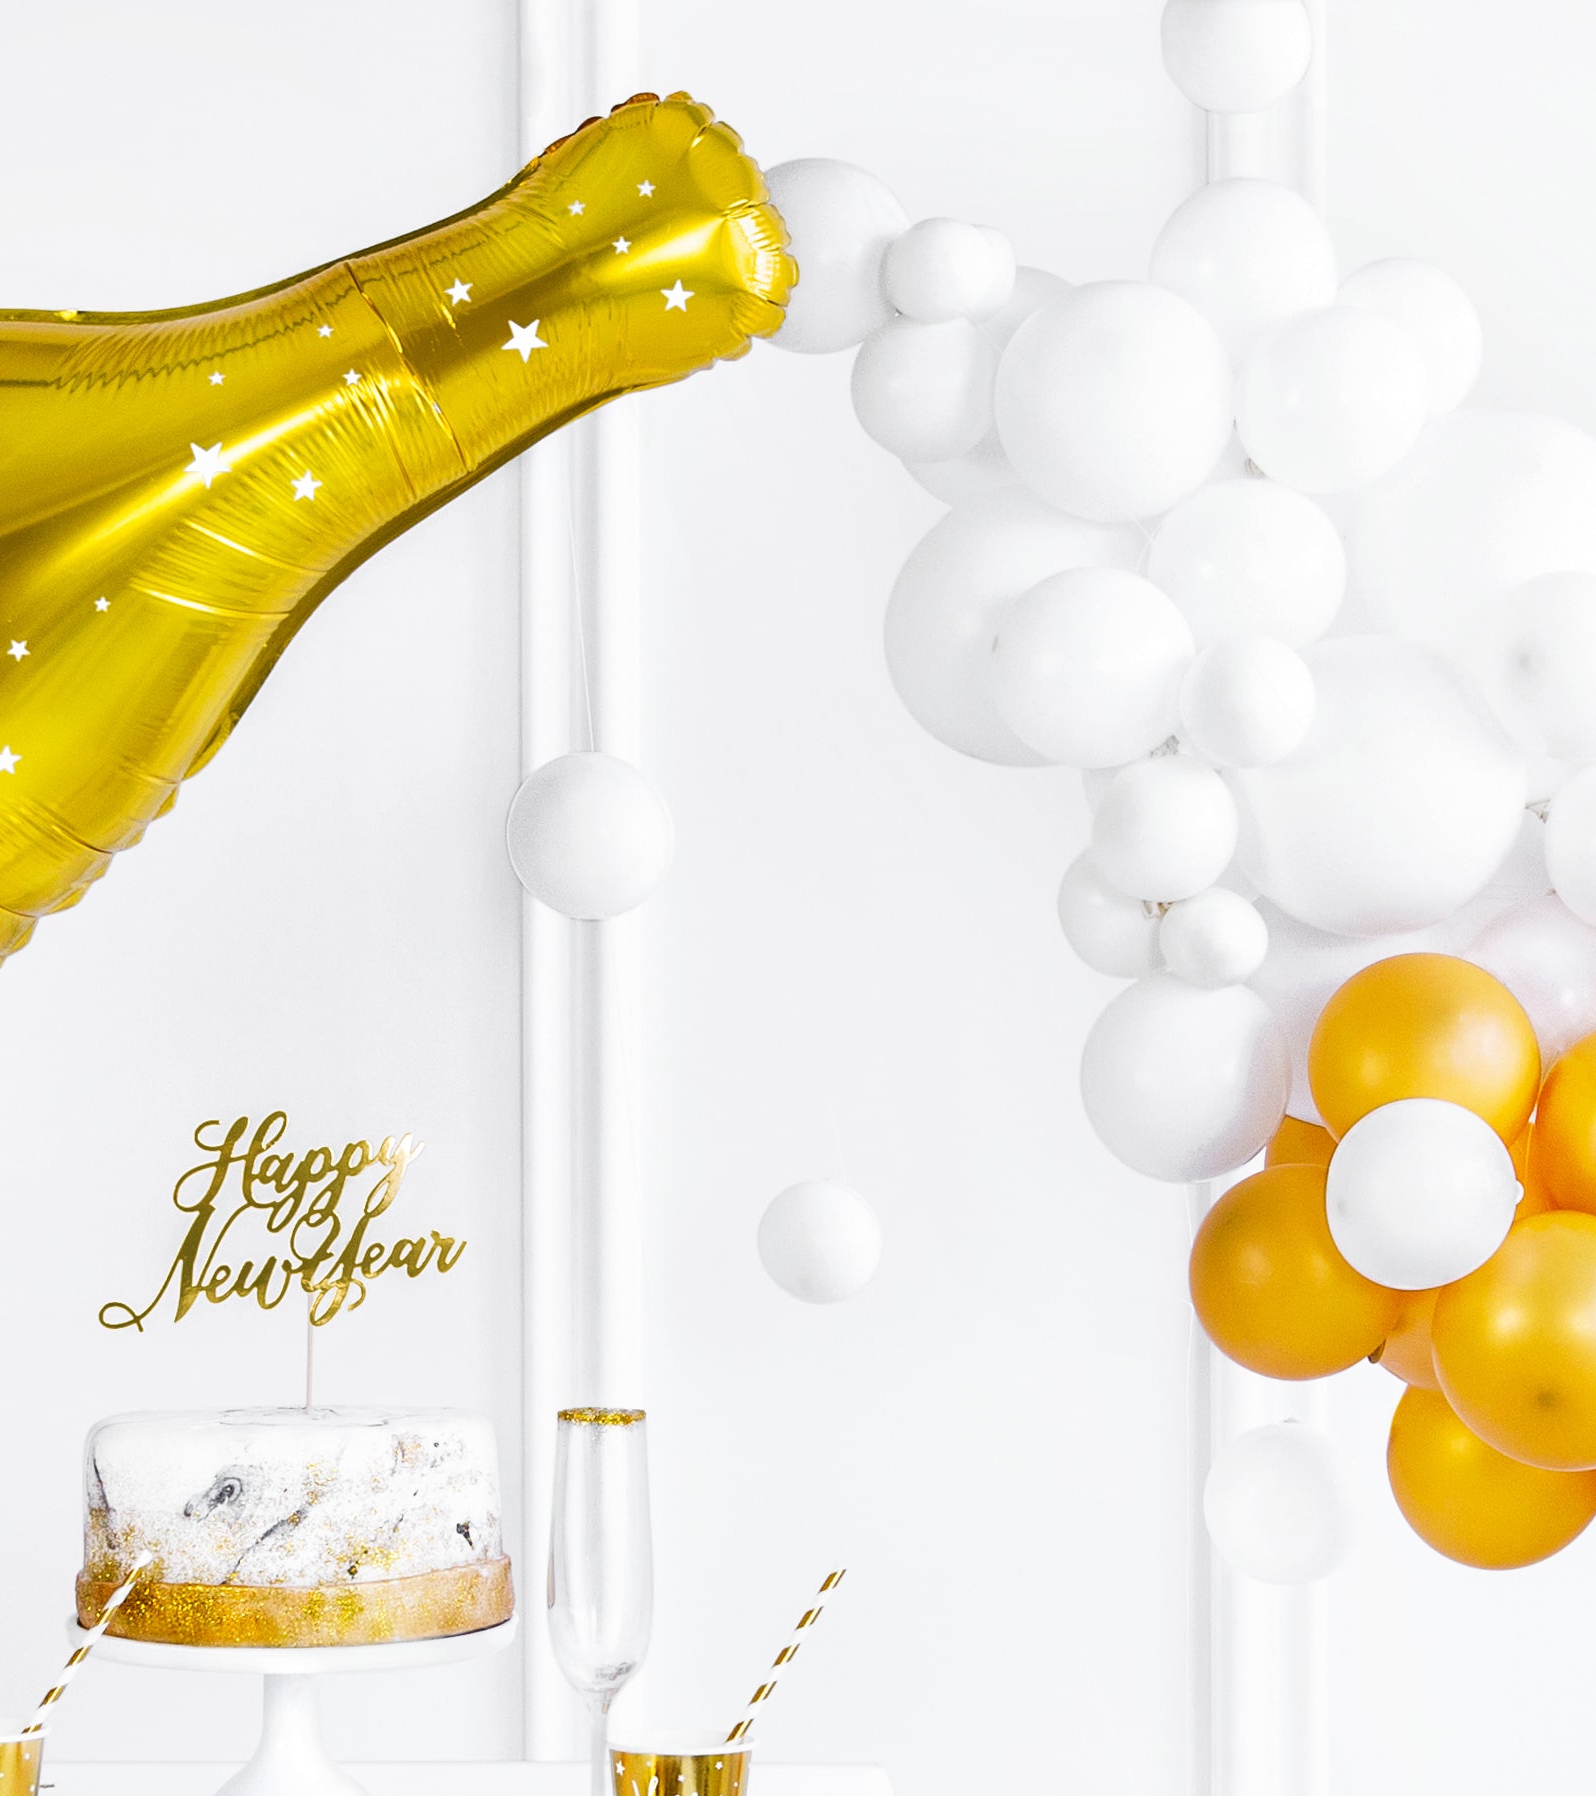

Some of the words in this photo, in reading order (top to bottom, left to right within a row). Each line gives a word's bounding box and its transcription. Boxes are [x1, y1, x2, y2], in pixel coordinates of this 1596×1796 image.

[173, 1110, 425, 1233] Happy
[99, 1203, 302, 1332] New
[290, 1208, 467, 1327] Year
